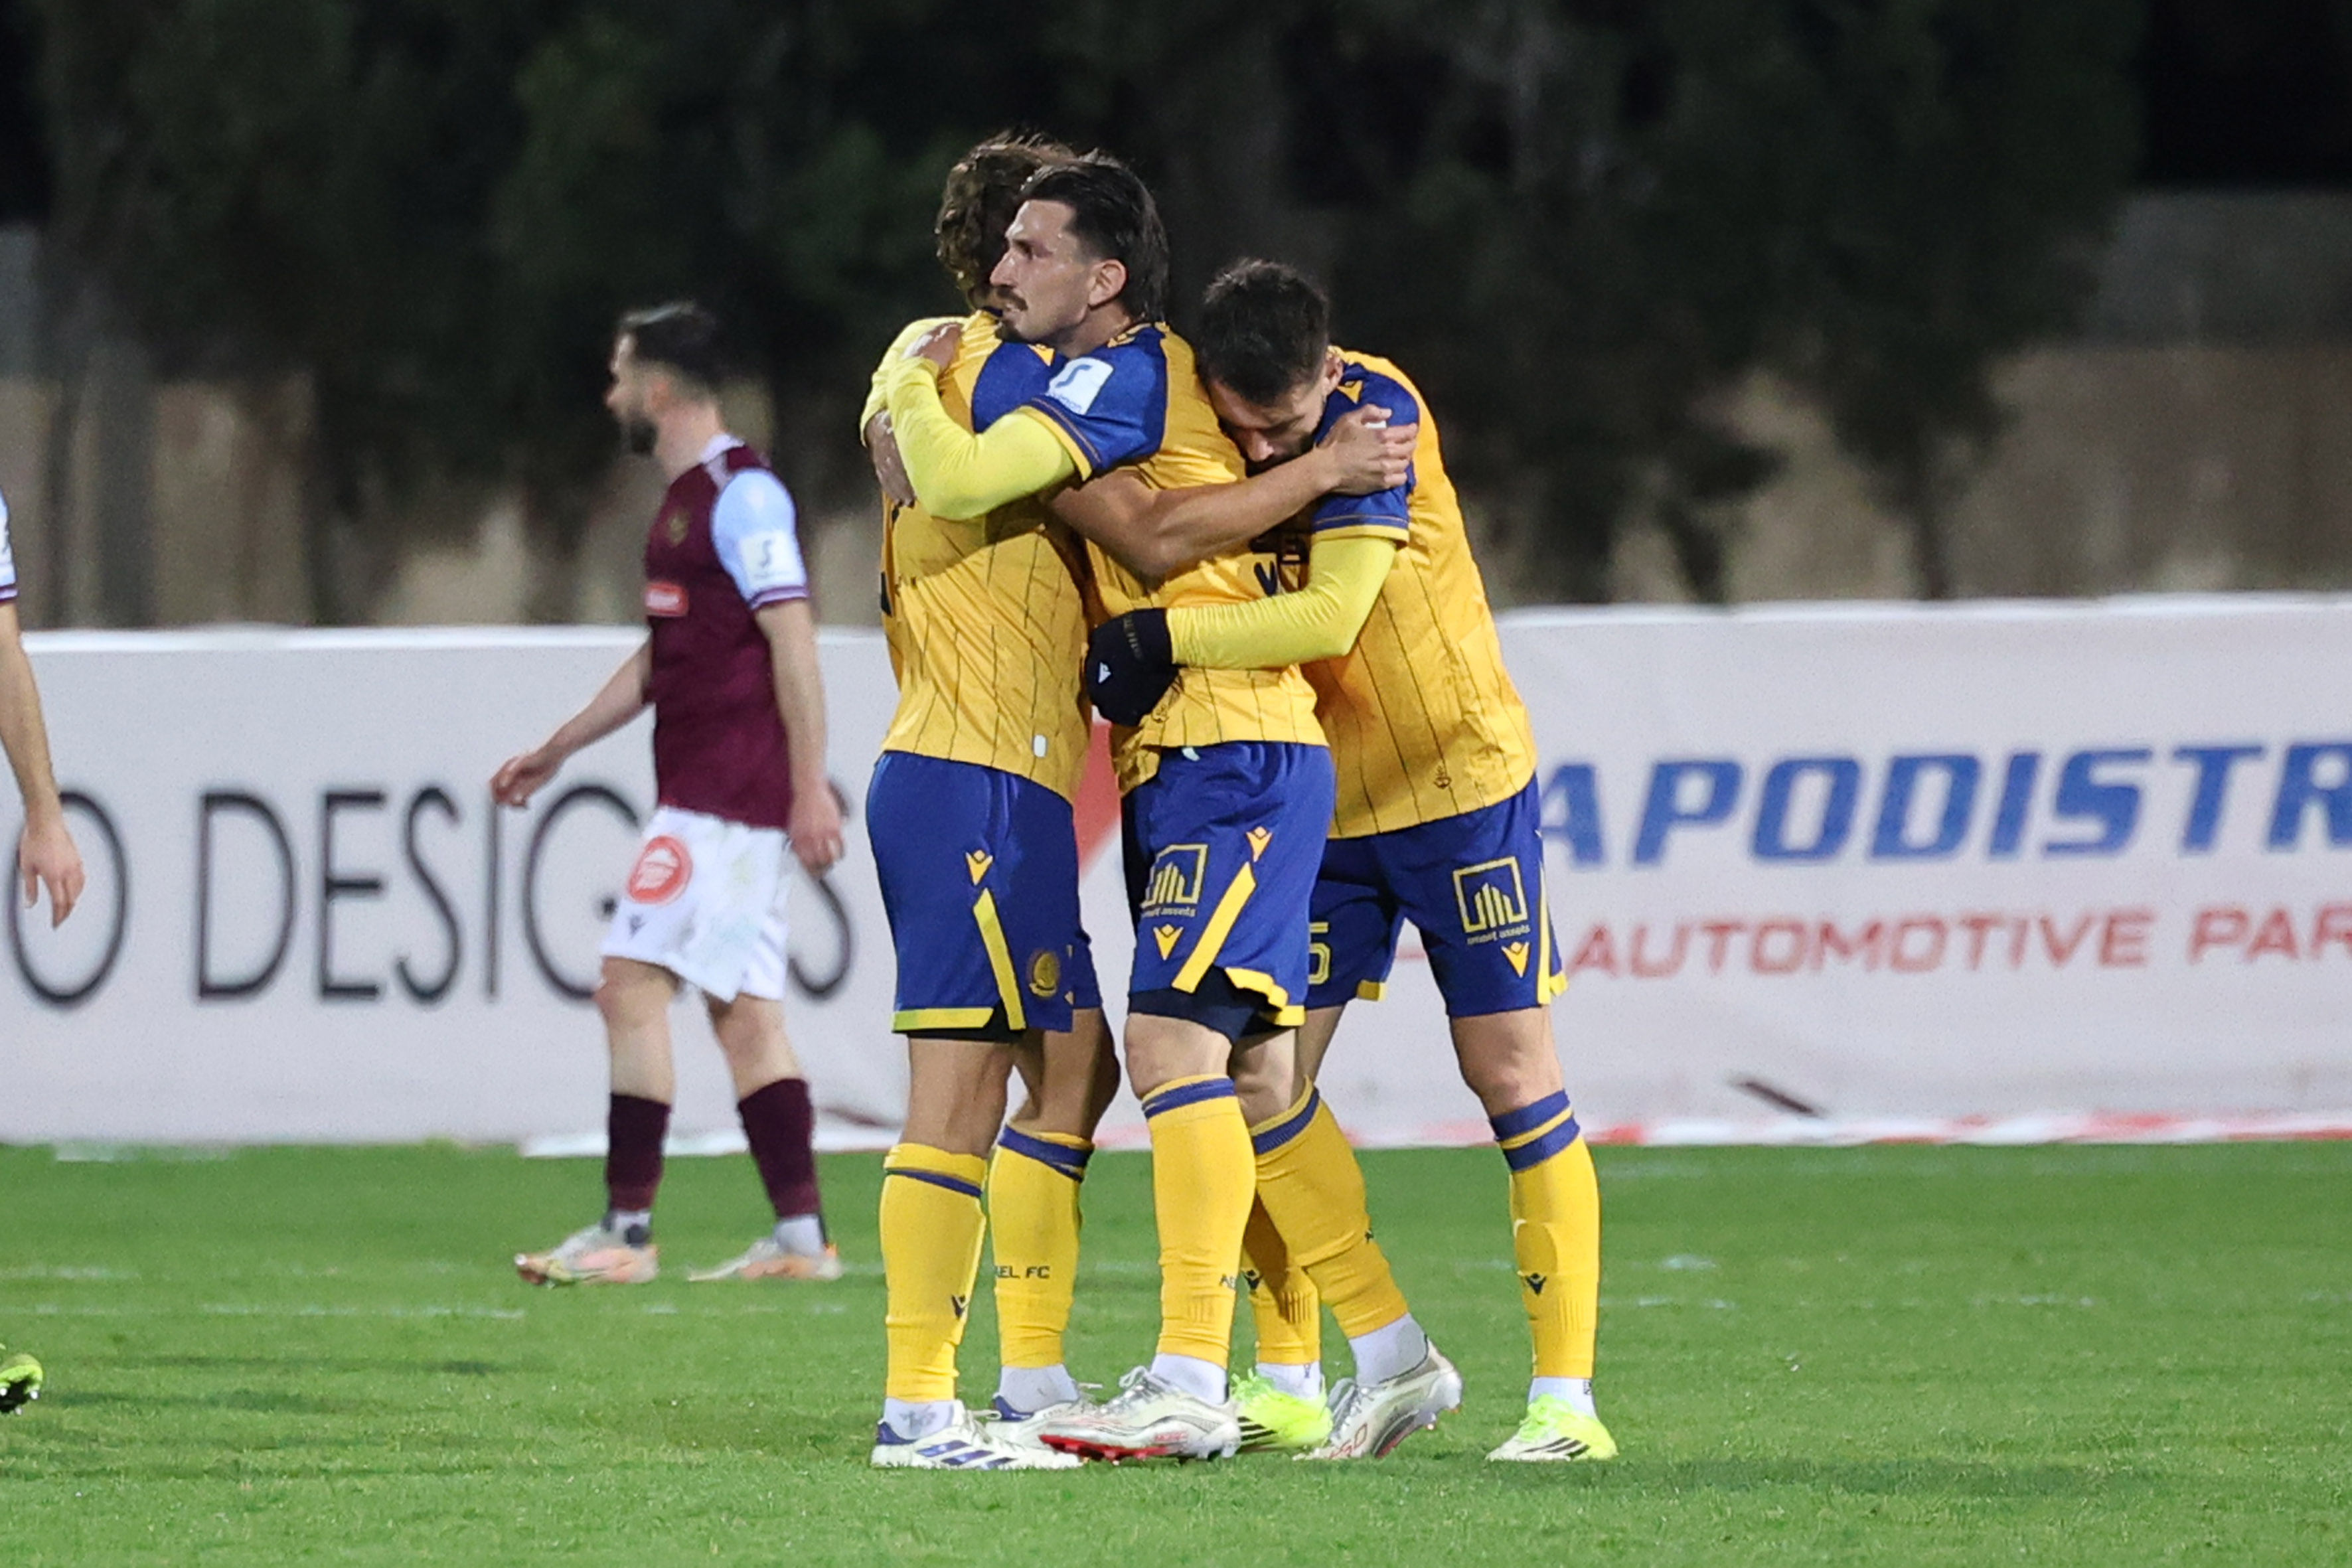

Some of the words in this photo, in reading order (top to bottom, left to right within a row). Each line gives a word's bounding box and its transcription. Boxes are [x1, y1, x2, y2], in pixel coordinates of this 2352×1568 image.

[198, 782, 854, 1001] DESIGS
[1567, 908, 2156, 979] AUTOMOTIVE
[995, 1265, 1021, 1279] EL
[1025, 1265, 1051, 1280] FC
